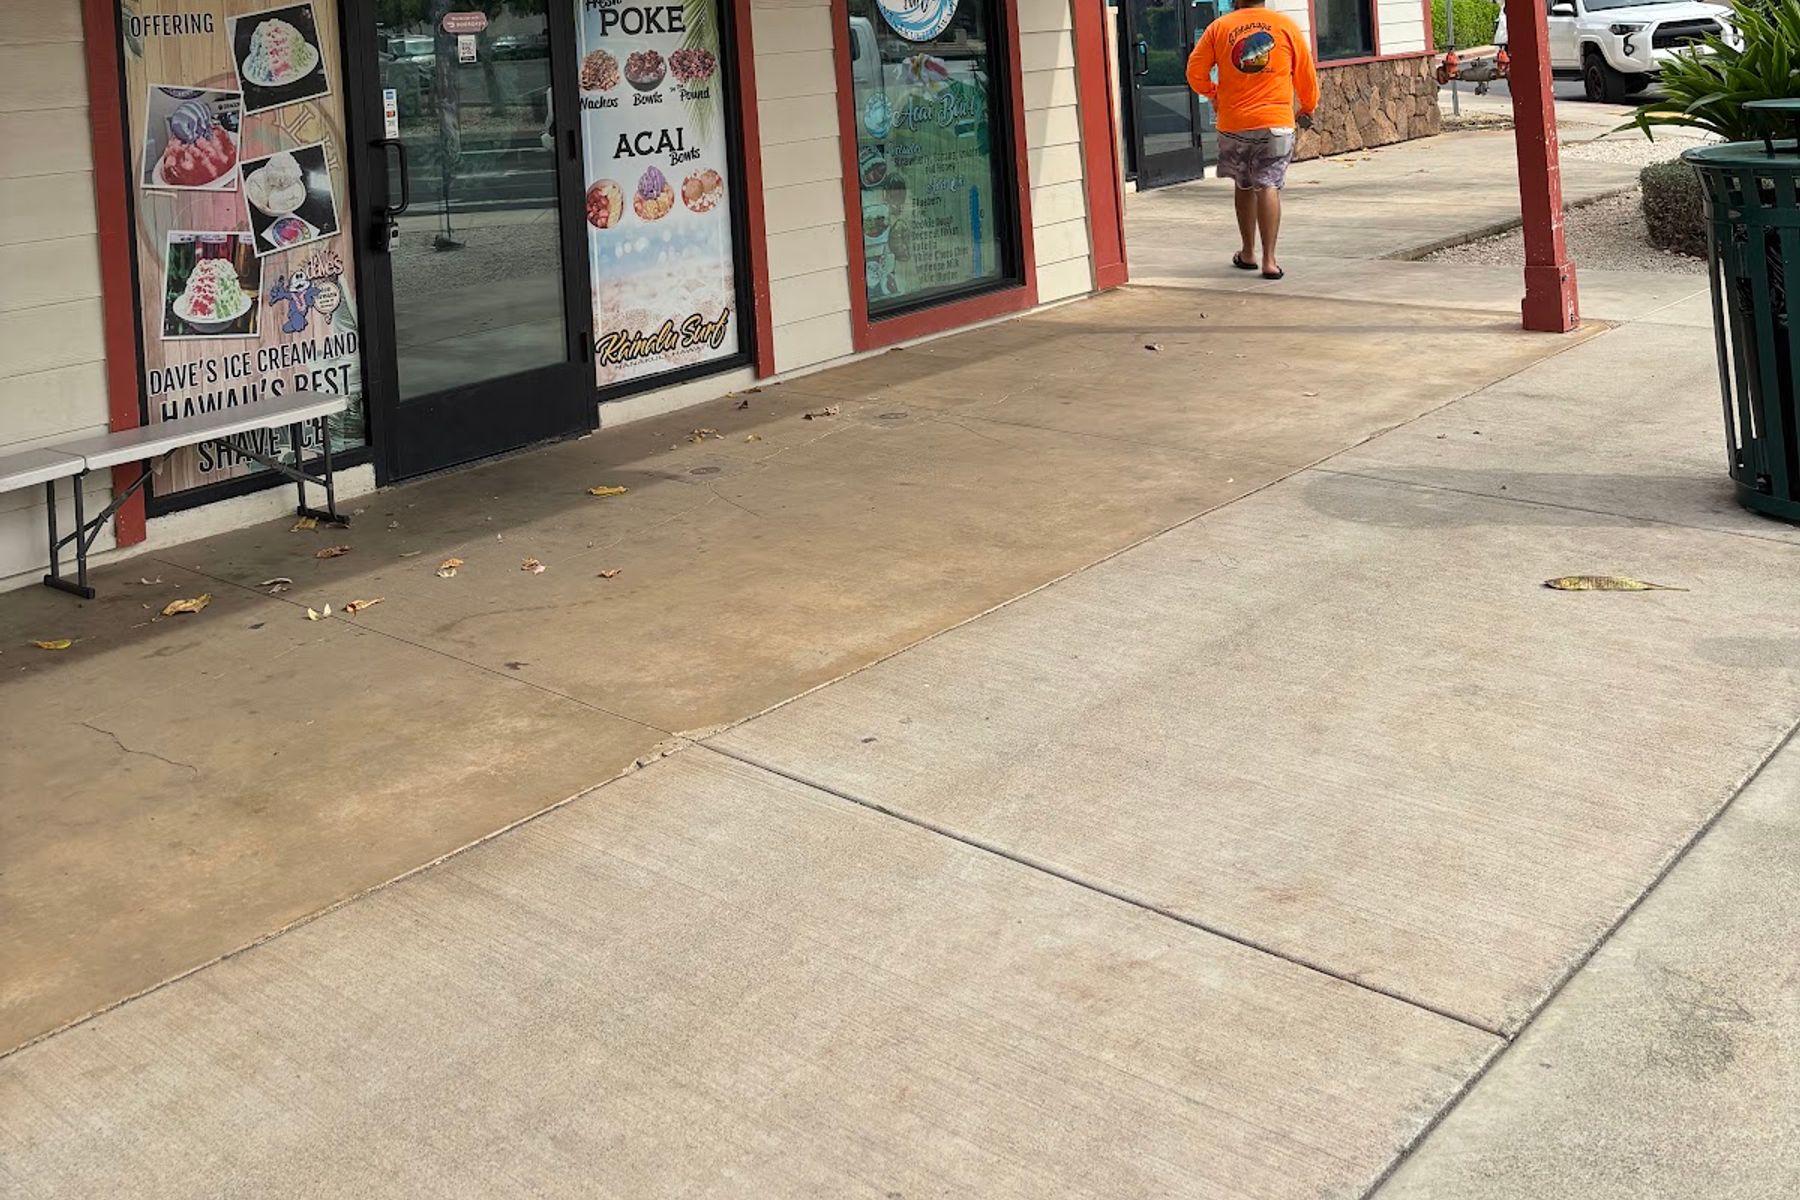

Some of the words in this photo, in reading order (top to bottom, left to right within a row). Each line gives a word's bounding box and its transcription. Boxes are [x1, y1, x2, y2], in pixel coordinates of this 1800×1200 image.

[130, 13, 214, 38] OFFERING
[600, 5, 686, 36] POKE
[580, 96, 619, 110] Nachos
[633, 91, 663, 106] Bowls
[680, 87, 710, 101] Pound
[613, 127, 685, 159] ACAI
[669, 147, 700, 166] Bowls
[596, 319, 679, 367] Kainalu
[680, 308, 730, 349] Surf
[150, 360, 217, 394] DAVE'S
[224, 353, 250, 379] ICE
[258, 340, 317, 372] CREAM
[323, 332, 357, 360] AND
